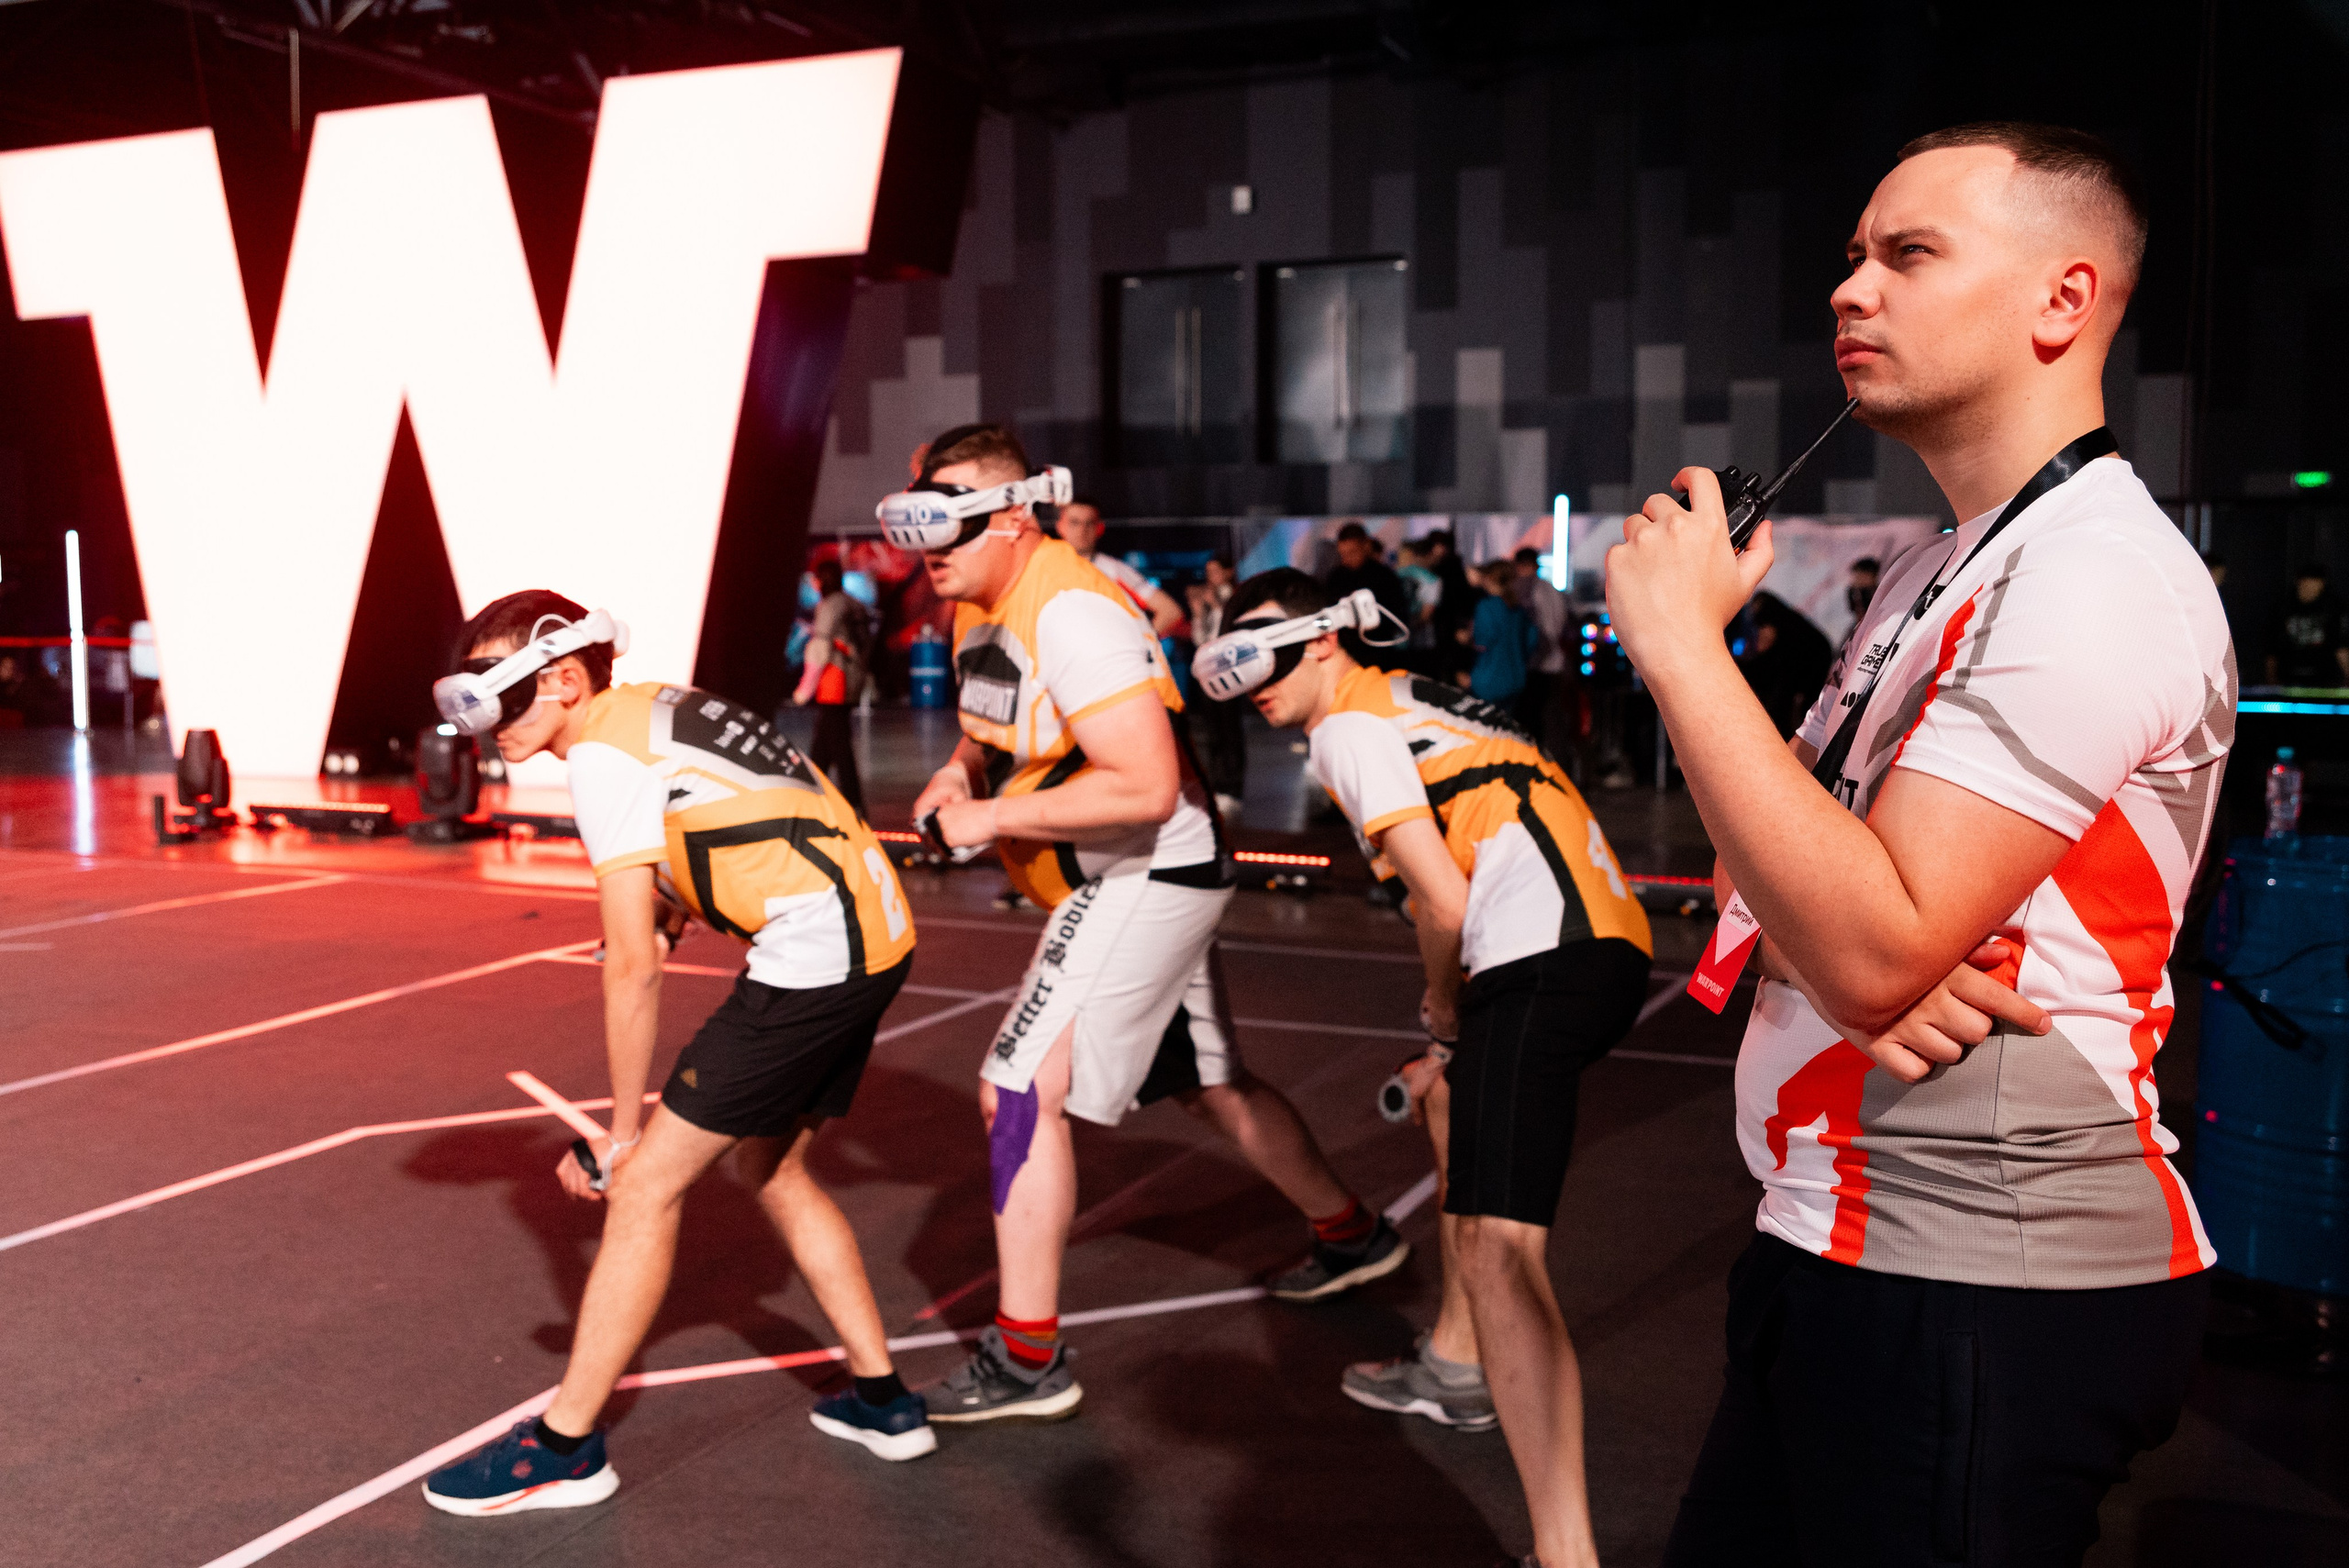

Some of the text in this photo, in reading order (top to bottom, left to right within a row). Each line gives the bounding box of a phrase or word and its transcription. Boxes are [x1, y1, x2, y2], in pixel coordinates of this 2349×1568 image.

[0, 48, 902, 785] W
[908, 504, 932, 525] 10
[1861, 654, 1883, 669] GAME
[863, 846, 908, 943] 2
[1697, 972, 1725, 997] WARPOINT
[996, 977, 1052, 1066] Better
